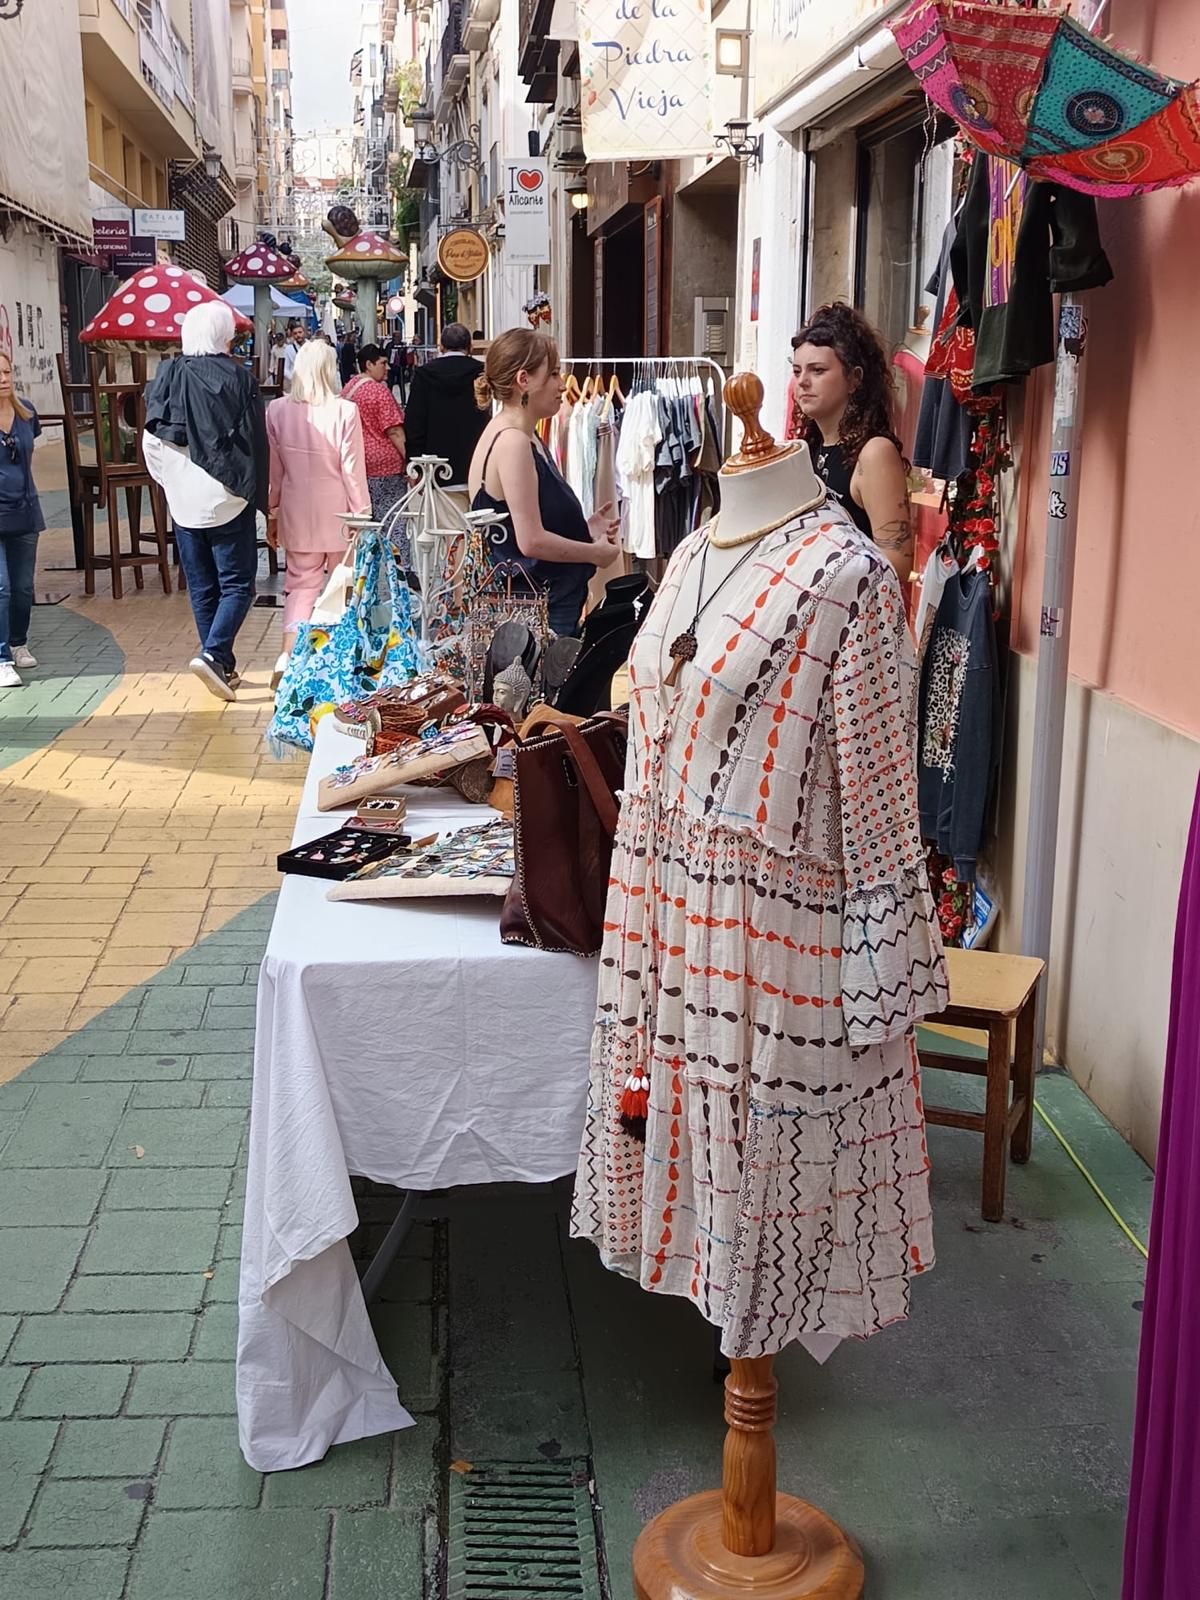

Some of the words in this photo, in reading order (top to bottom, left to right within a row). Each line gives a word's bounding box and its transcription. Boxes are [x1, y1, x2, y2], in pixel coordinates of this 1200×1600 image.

[615, 0, 643, 20] de
[651, 0, 678, 18] la
[591, 39, 692, 80] Piedra
[609, 86, 685, 120] Vieja
[508, 166, 518, 193] I
[508, 194, 544, 206] Alicante
